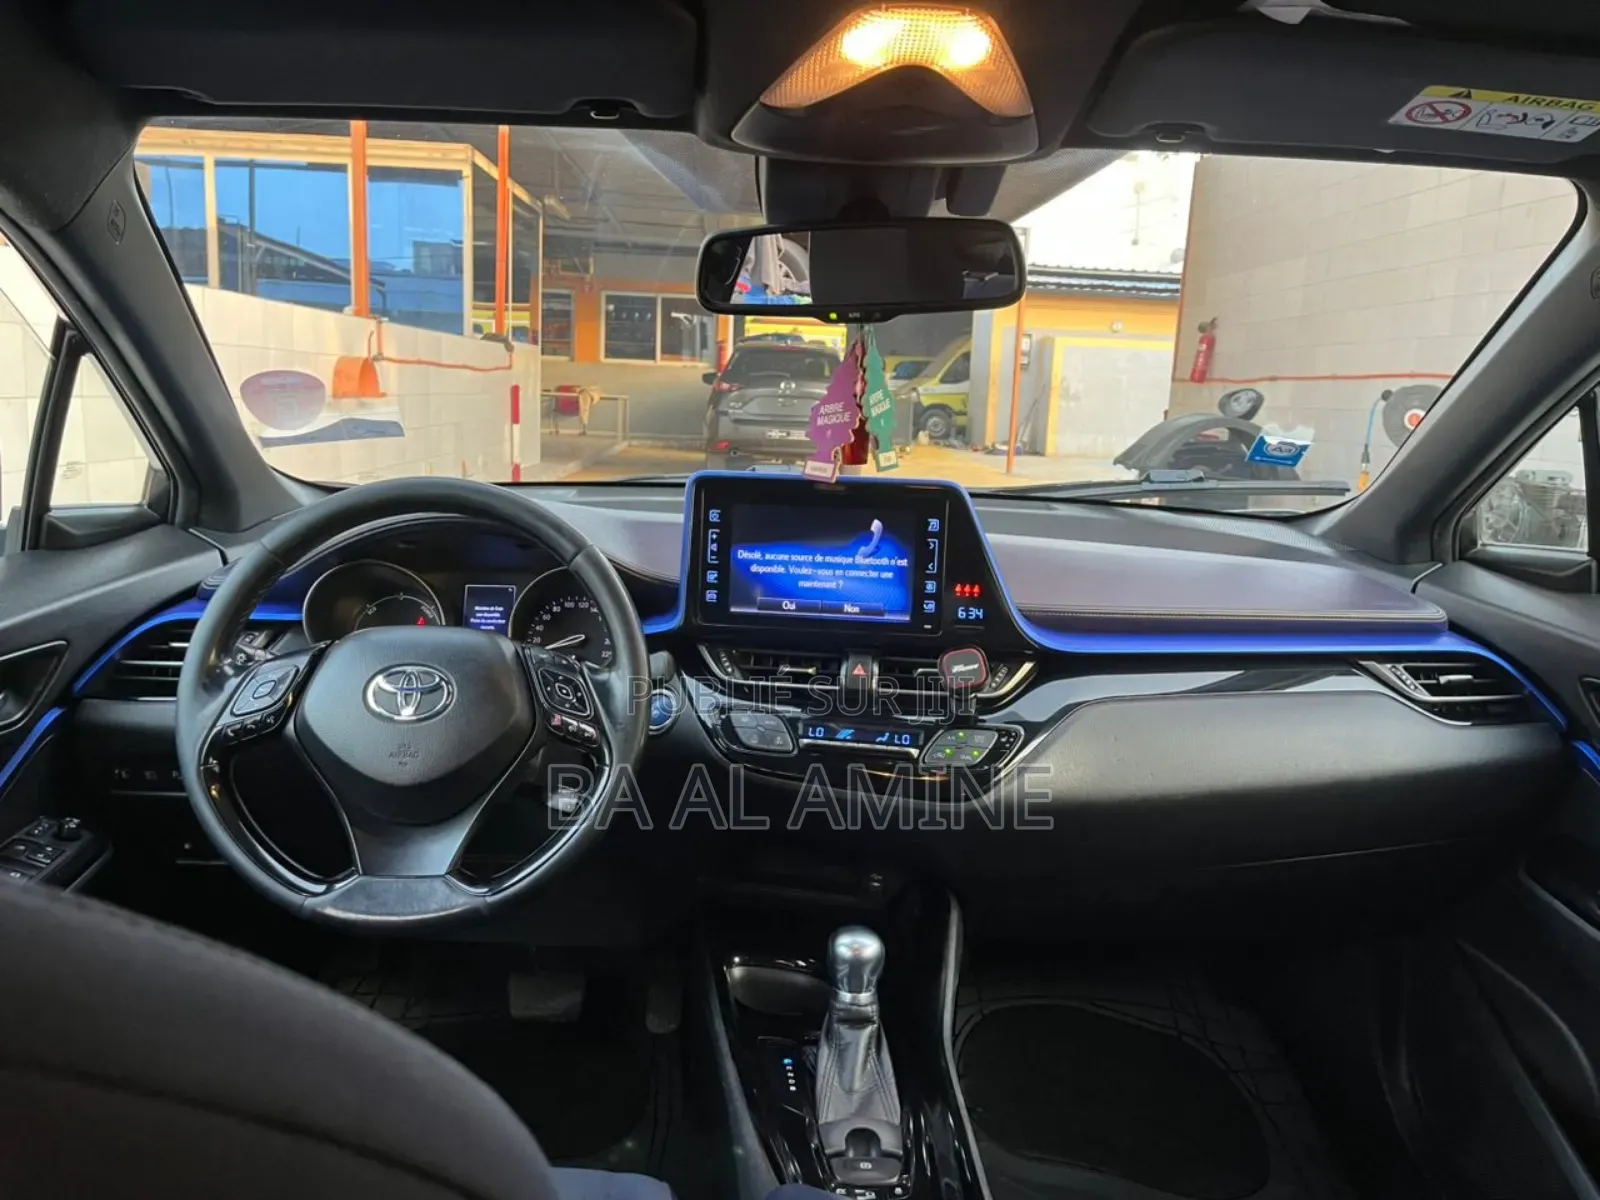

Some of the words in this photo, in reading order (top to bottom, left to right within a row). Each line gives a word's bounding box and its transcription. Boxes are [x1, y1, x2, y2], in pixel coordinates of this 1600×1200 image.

[1502, 94, 1595, 110] AIRBAG
[819, 401, 845, 415] ARBRE
[816, 411, 852, 427] MAGIQUE
[765, 553, 789, 562] aucune
[791, 554, 813, 563] source
[814, 553, 824, 563] de
[825, 554, 853, 565] musique
[855, 554, 890, 566] Bluetooth
[845, 568, 879, 579] connecter
[880, 571, 894, 579] une
[782, 600, 796, 610] Oui
[844, 603, 860, 613] Non
